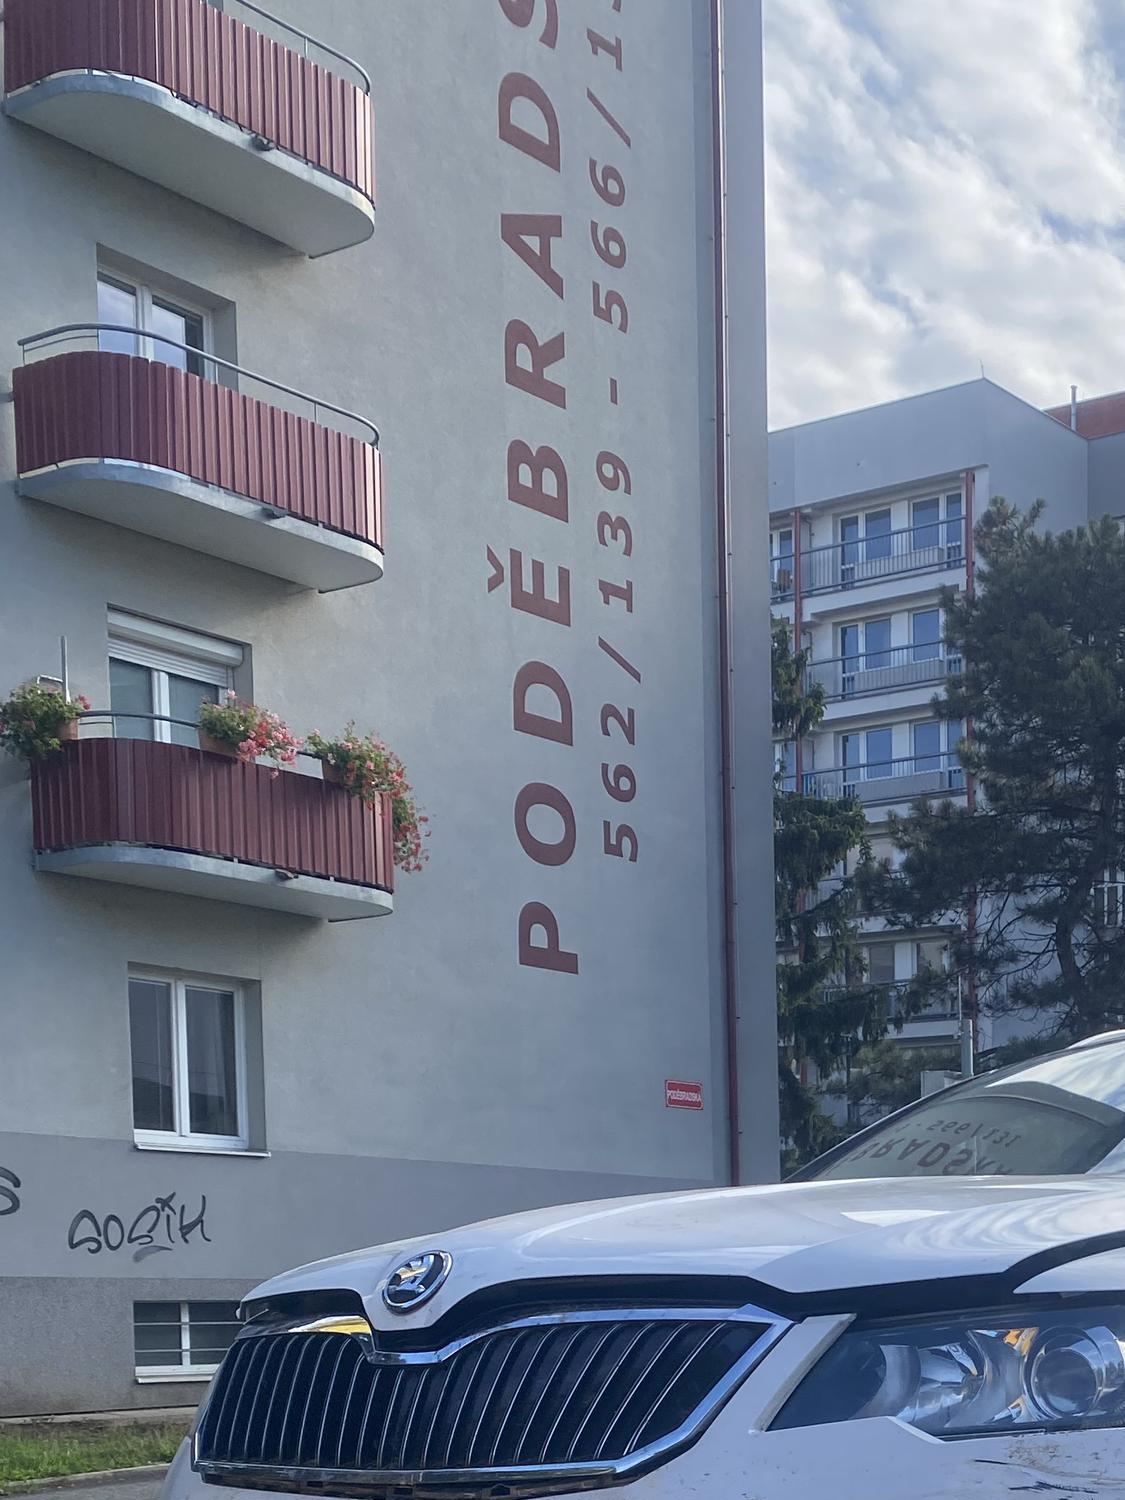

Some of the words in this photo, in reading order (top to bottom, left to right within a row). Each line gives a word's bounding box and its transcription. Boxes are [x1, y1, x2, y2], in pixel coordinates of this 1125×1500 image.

[587, 0, 631, 334] 566/1
[610, 378, 618, 405] -
[596, 451, 641, 863] 562/139
